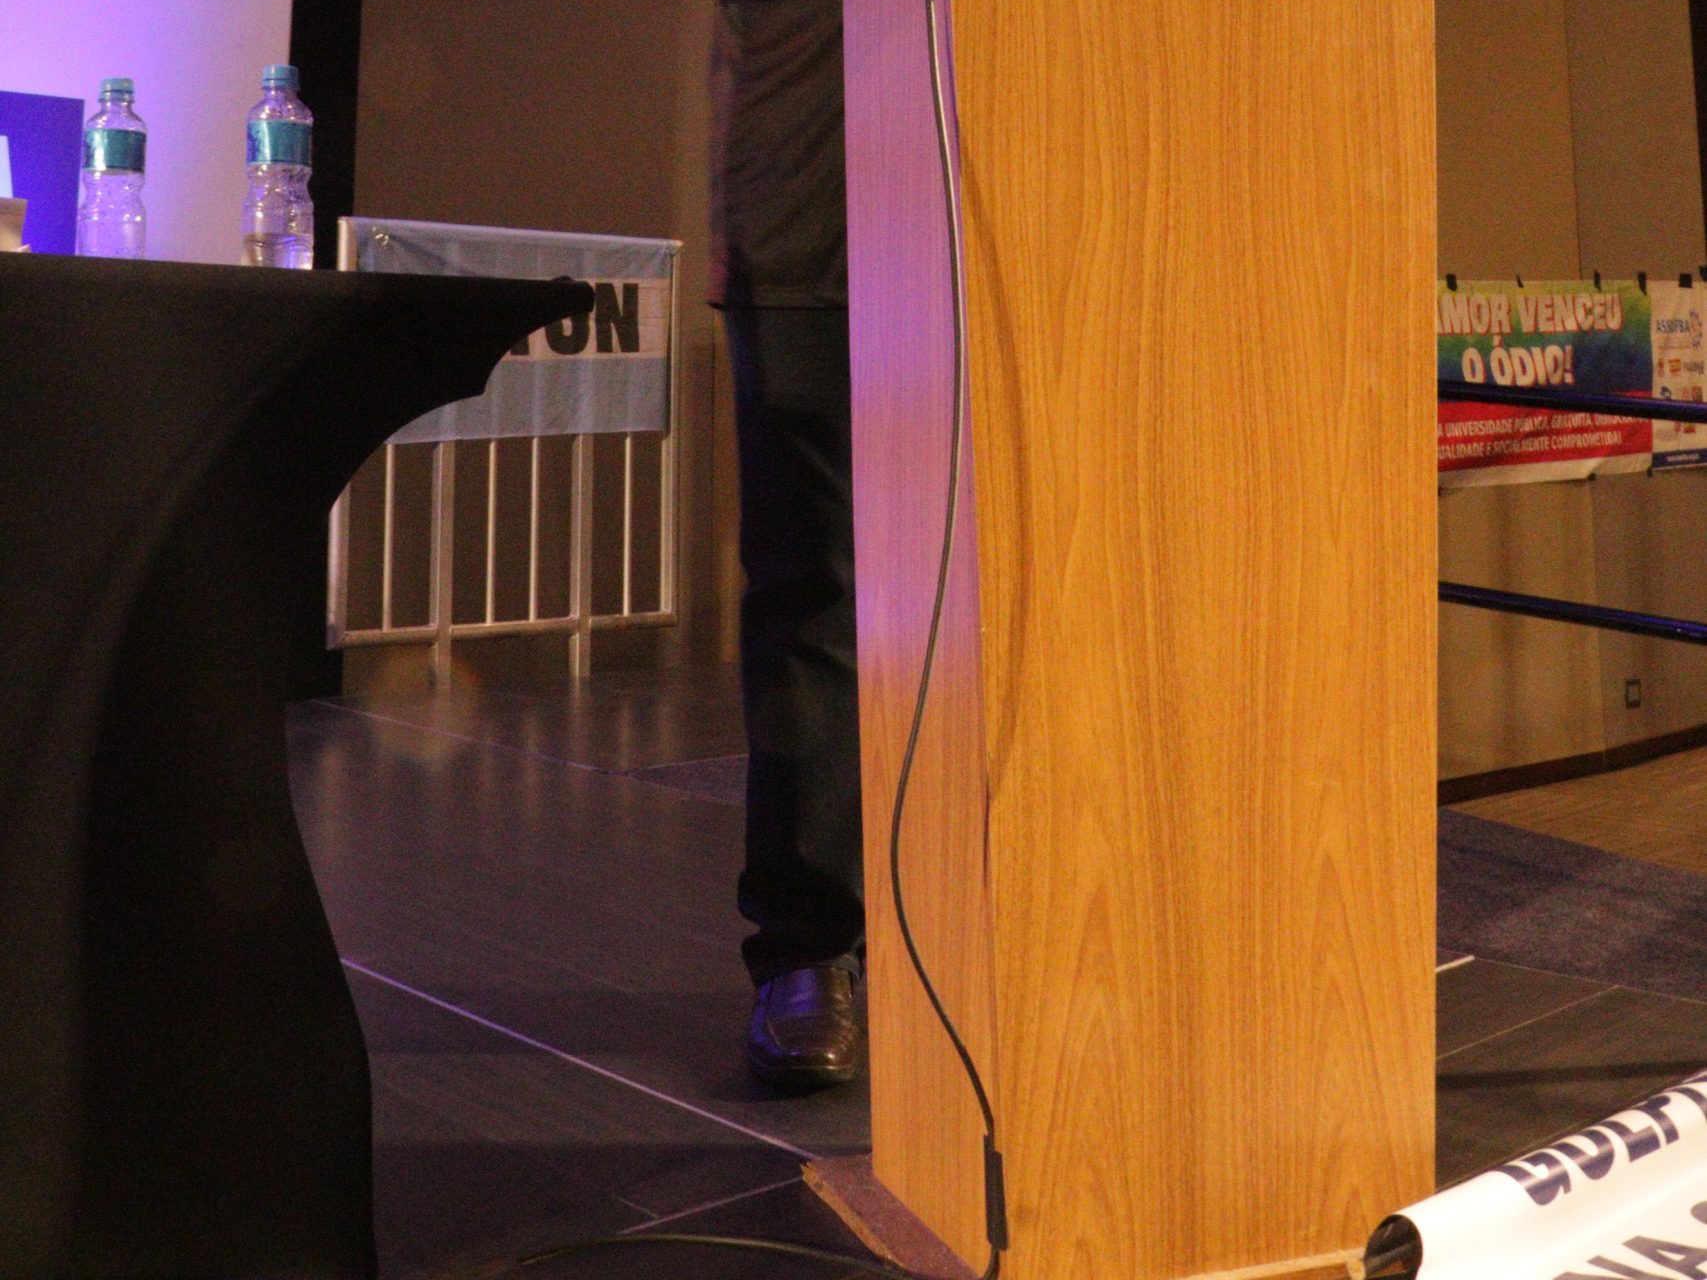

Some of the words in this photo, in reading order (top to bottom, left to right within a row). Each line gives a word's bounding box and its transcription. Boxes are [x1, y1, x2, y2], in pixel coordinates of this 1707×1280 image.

[1519, 292, 1625, 334] VENCEU
[1461, 347, 1486, 384] O
[1490, 334, 1575, 386] ÓDIO!
[1438, 441, 1484, 460] UALIDADE
[1493, 435, 1550, 456] SOCIALMENTE
[1551, 430, 1623, 450] COMPROMETIDA!
[1446, 418, 1513, 437] UNIVERSIDADE
